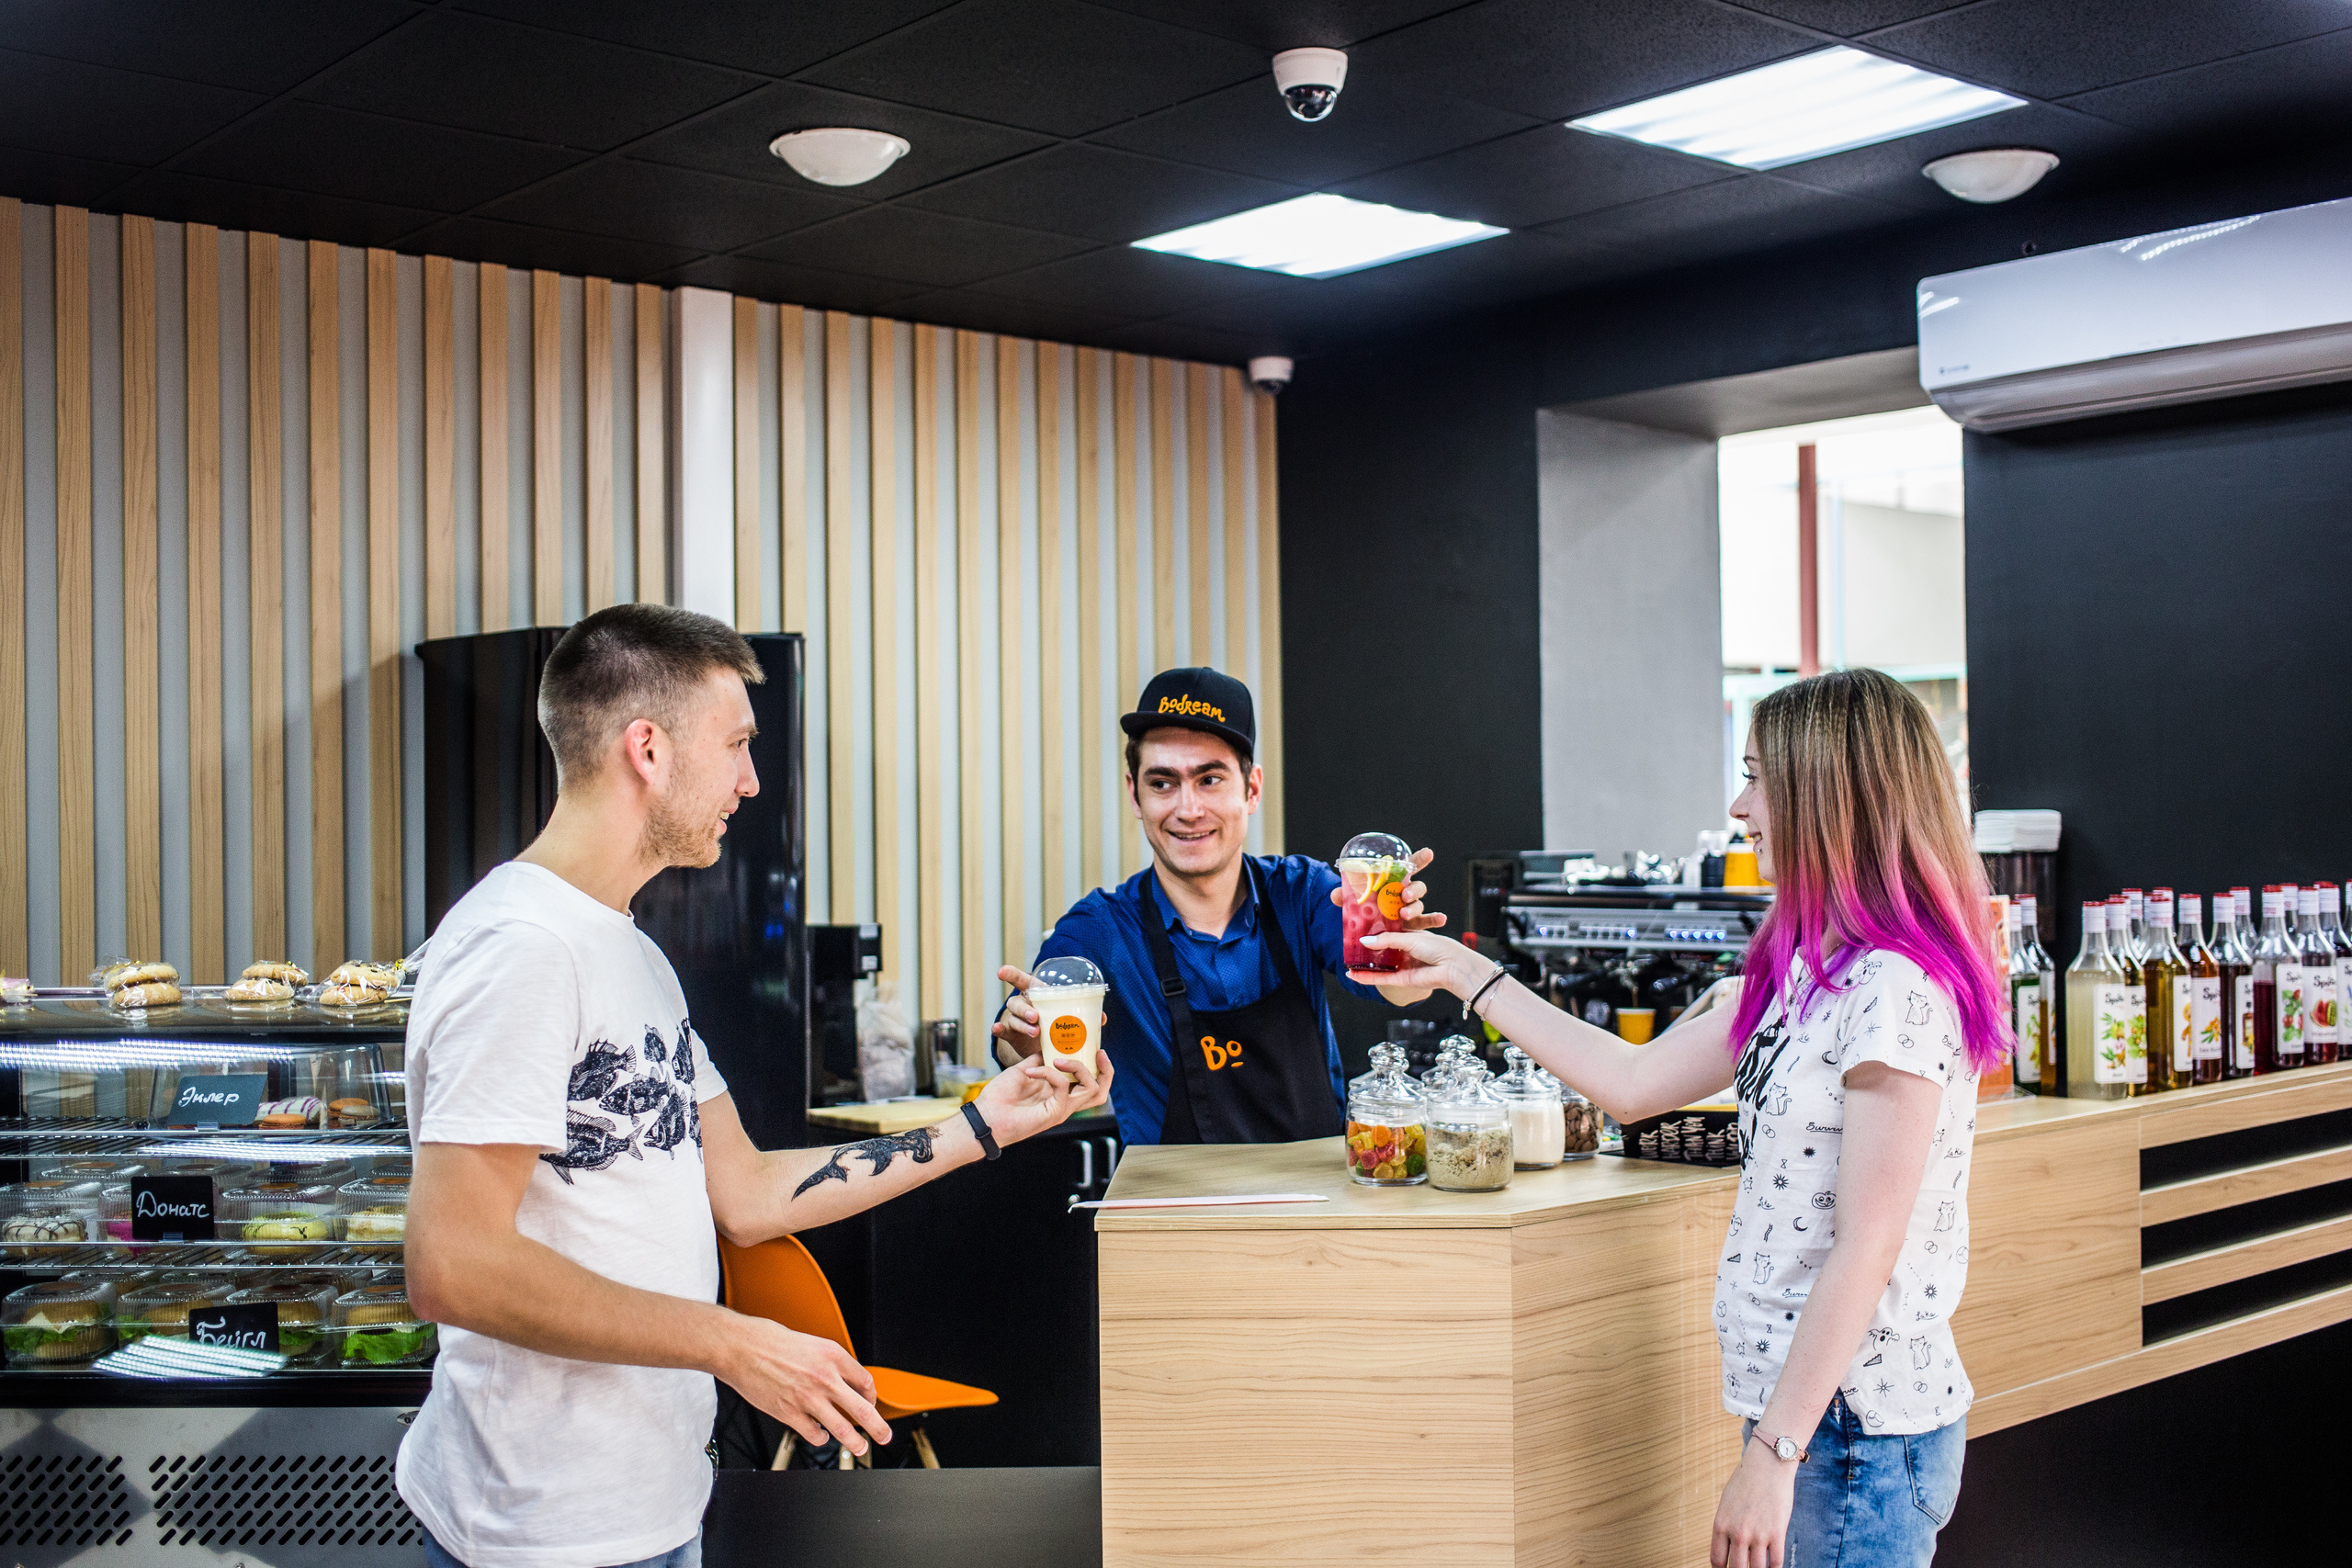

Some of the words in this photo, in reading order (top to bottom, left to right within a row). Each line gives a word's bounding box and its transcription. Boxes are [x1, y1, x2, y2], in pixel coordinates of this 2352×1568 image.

[1200, 1035, 1244, 1071] Bo
[178, 1086, 240, 1108] Эклер
[136, 1190, 210, 1219] Донатс
